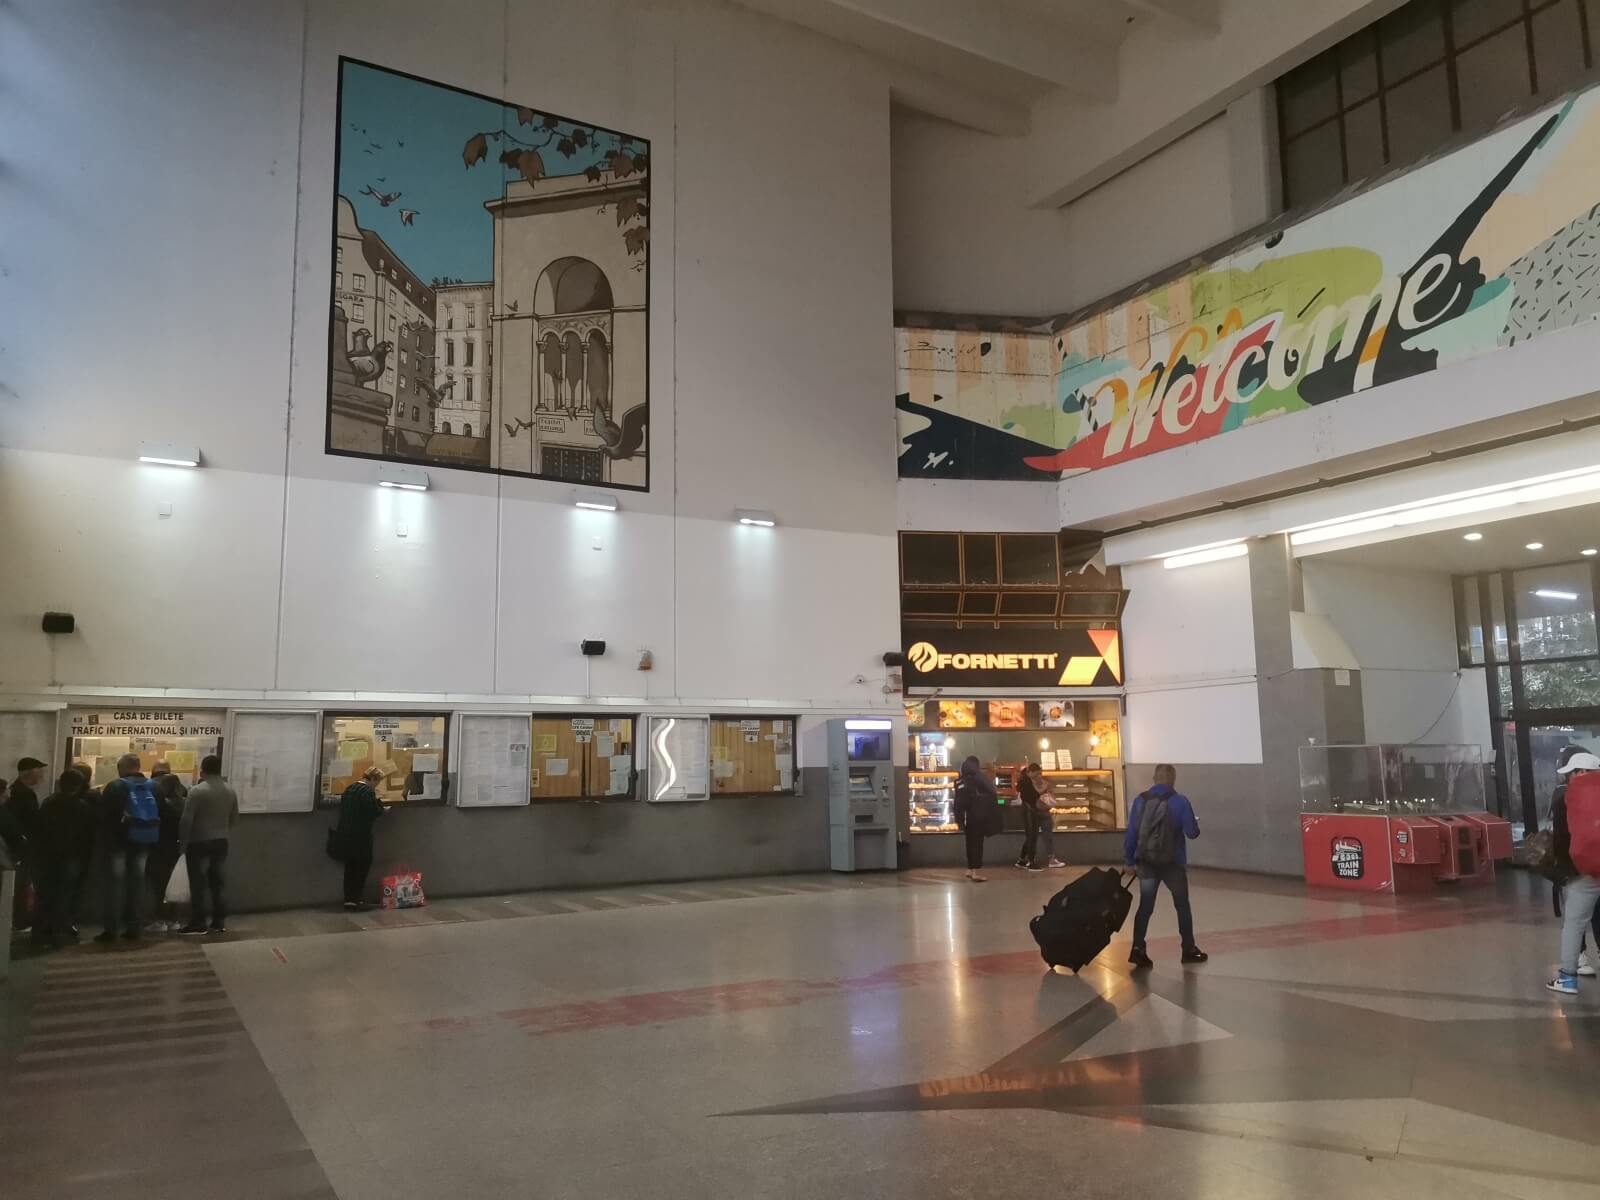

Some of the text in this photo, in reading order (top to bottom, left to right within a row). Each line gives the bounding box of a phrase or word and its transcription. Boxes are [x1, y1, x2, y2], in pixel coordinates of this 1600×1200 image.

[1092, 253, 1462, 460] Welcome
[938, 653, 1056, 669] FORNETTI
[113, 712, 184, 720] CASA DE BILETE
[71, 726, 104, 735] TRAFIC
[106, 726, 177, 735] INTERNATIONAL
[190, 726, 222, 735] INTERN
[1337, 860, 1359, 869] TRAIN
[1339, 869, 1359, 877] ZONE
